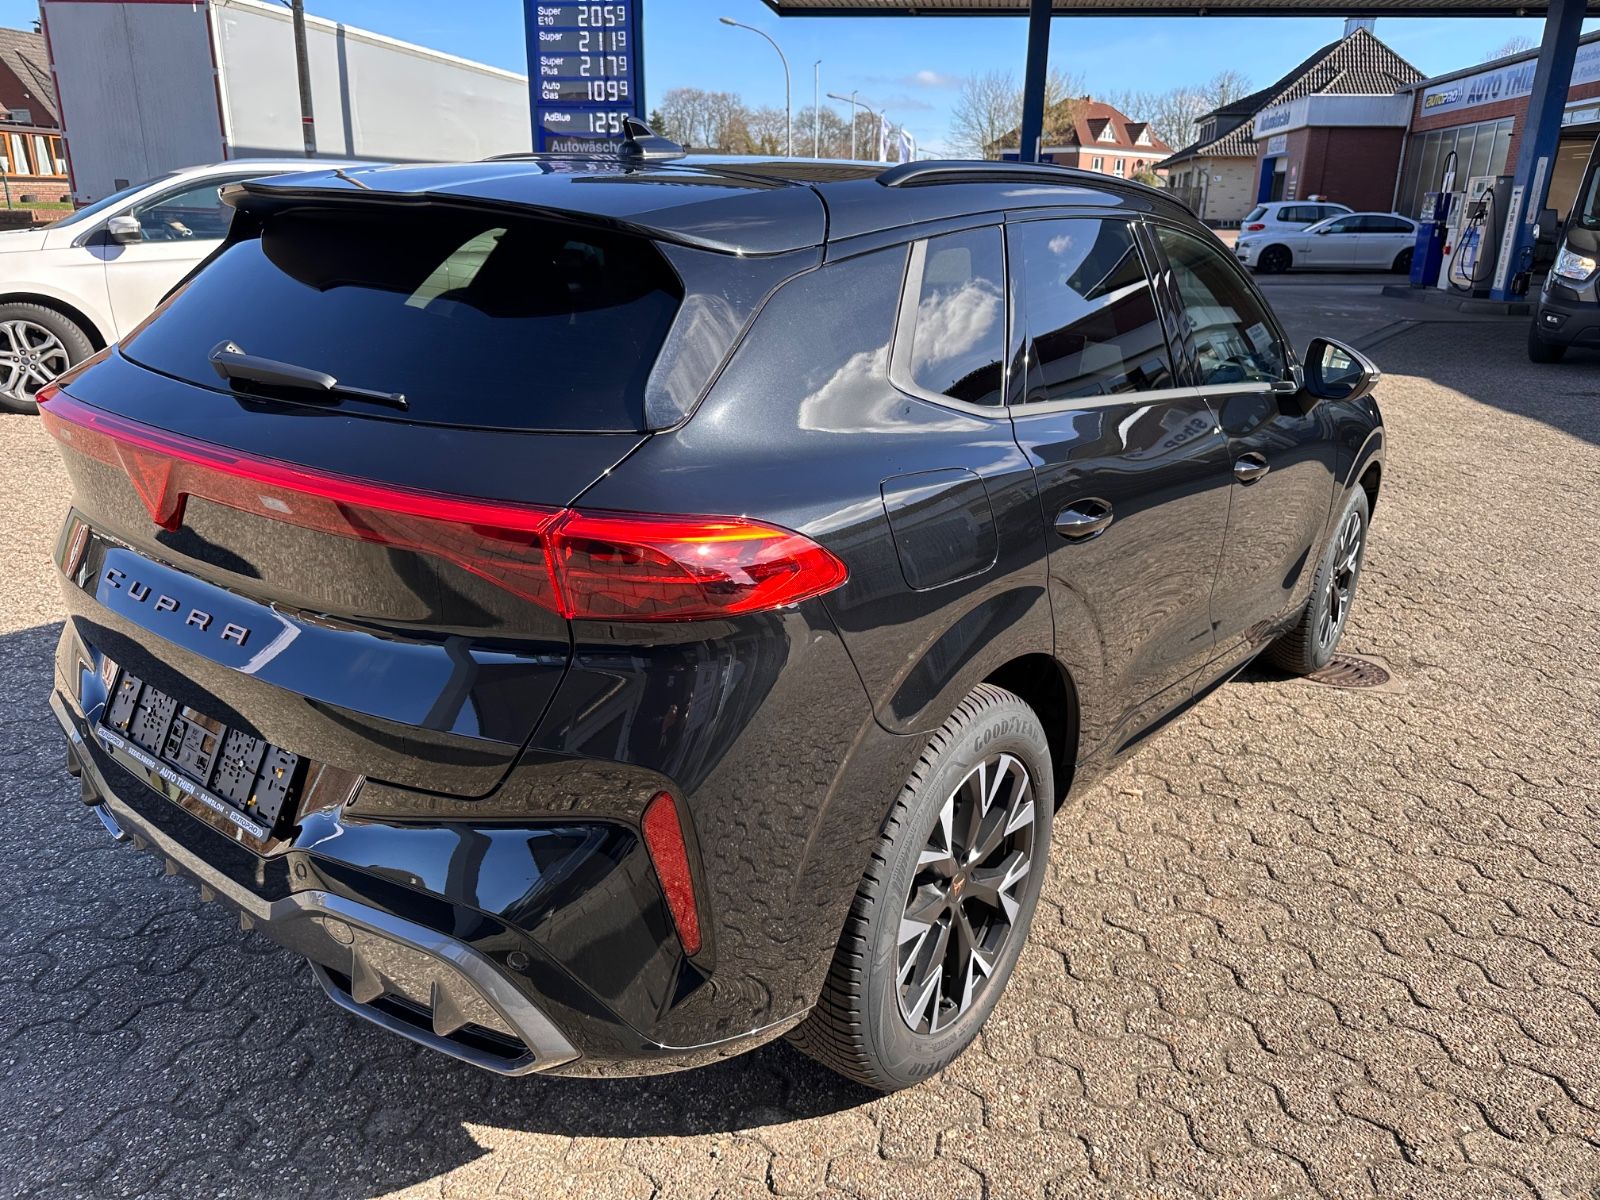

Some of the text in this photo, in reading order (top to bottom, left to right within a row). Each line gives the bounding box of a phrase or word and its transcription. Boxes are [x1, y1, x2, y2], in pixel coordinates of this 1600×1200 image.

[537, 6, 625, 27] Super 2059
[538, 17, 554, 25] E10
[539, 31, 626, 52] Super 2119
[540, 56, 627, 76] Super 2179
[541, 67, 558, 75] Plus
[542, 81, 628, 101] Auto 1099
[542, 91, 559, 100] Gas
[1467, 75, 1502, 104] AUTO
[544, 112, 571, 122] AdBlue
[551, 140, 621, 153] Autowäsch
[104, 568, 251, 646] CUPRA
[974, 716, 1039, 752] GOODYEAR
[159, 767, 177, 782] AUTO
[177, 777, 196, 795] THIEN
